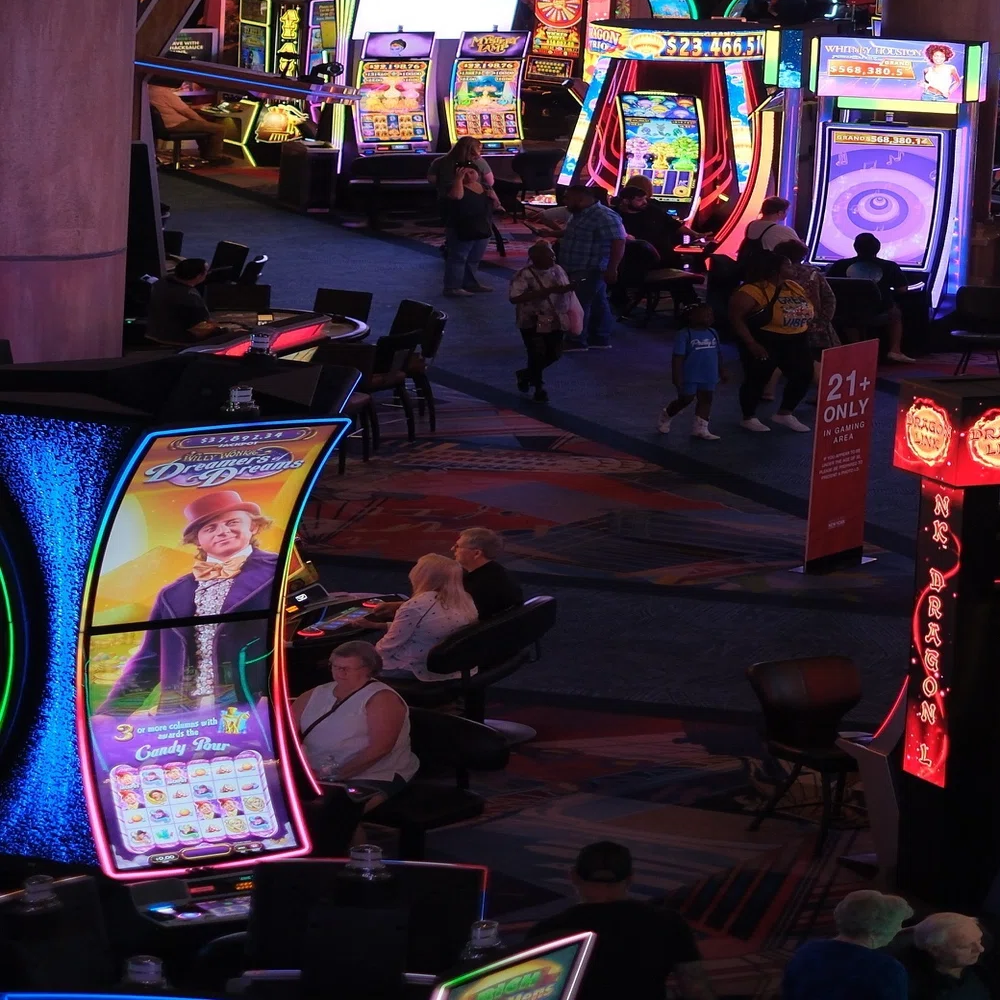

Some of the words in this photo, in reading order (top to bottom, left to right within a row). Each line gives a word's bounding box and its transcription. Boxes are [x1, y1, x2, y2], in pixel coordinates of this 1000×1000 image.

[826, 369, 871, 402] 21+
[823, 397, 870, 424] ONLY
[823, 428, 832, 437] IN
[834, 420, 865, 435] GAMING
[833, 433, 854, 444] AREA
[907, 412, 952, 439] DRAGON
[914, 432, 941, 450] LINK
[143, 455, 271, 484] Dreamers
[183, 451, 218, 463] WILLY
[185, 458, 306, 489] Dreams
[920, 566, 947, 726] DRAGON
[114, 723, 135, 741] 3
[148, 724, 167, 733] more
[168, 720, 200, 731] columns
[200, 717, 218, 727] with
[157, 731, 185, 740] awards
[186, 728, 199, 738] the
[135, 742, 187, 762] Candy
[192, 736, 231, 752] Pour
